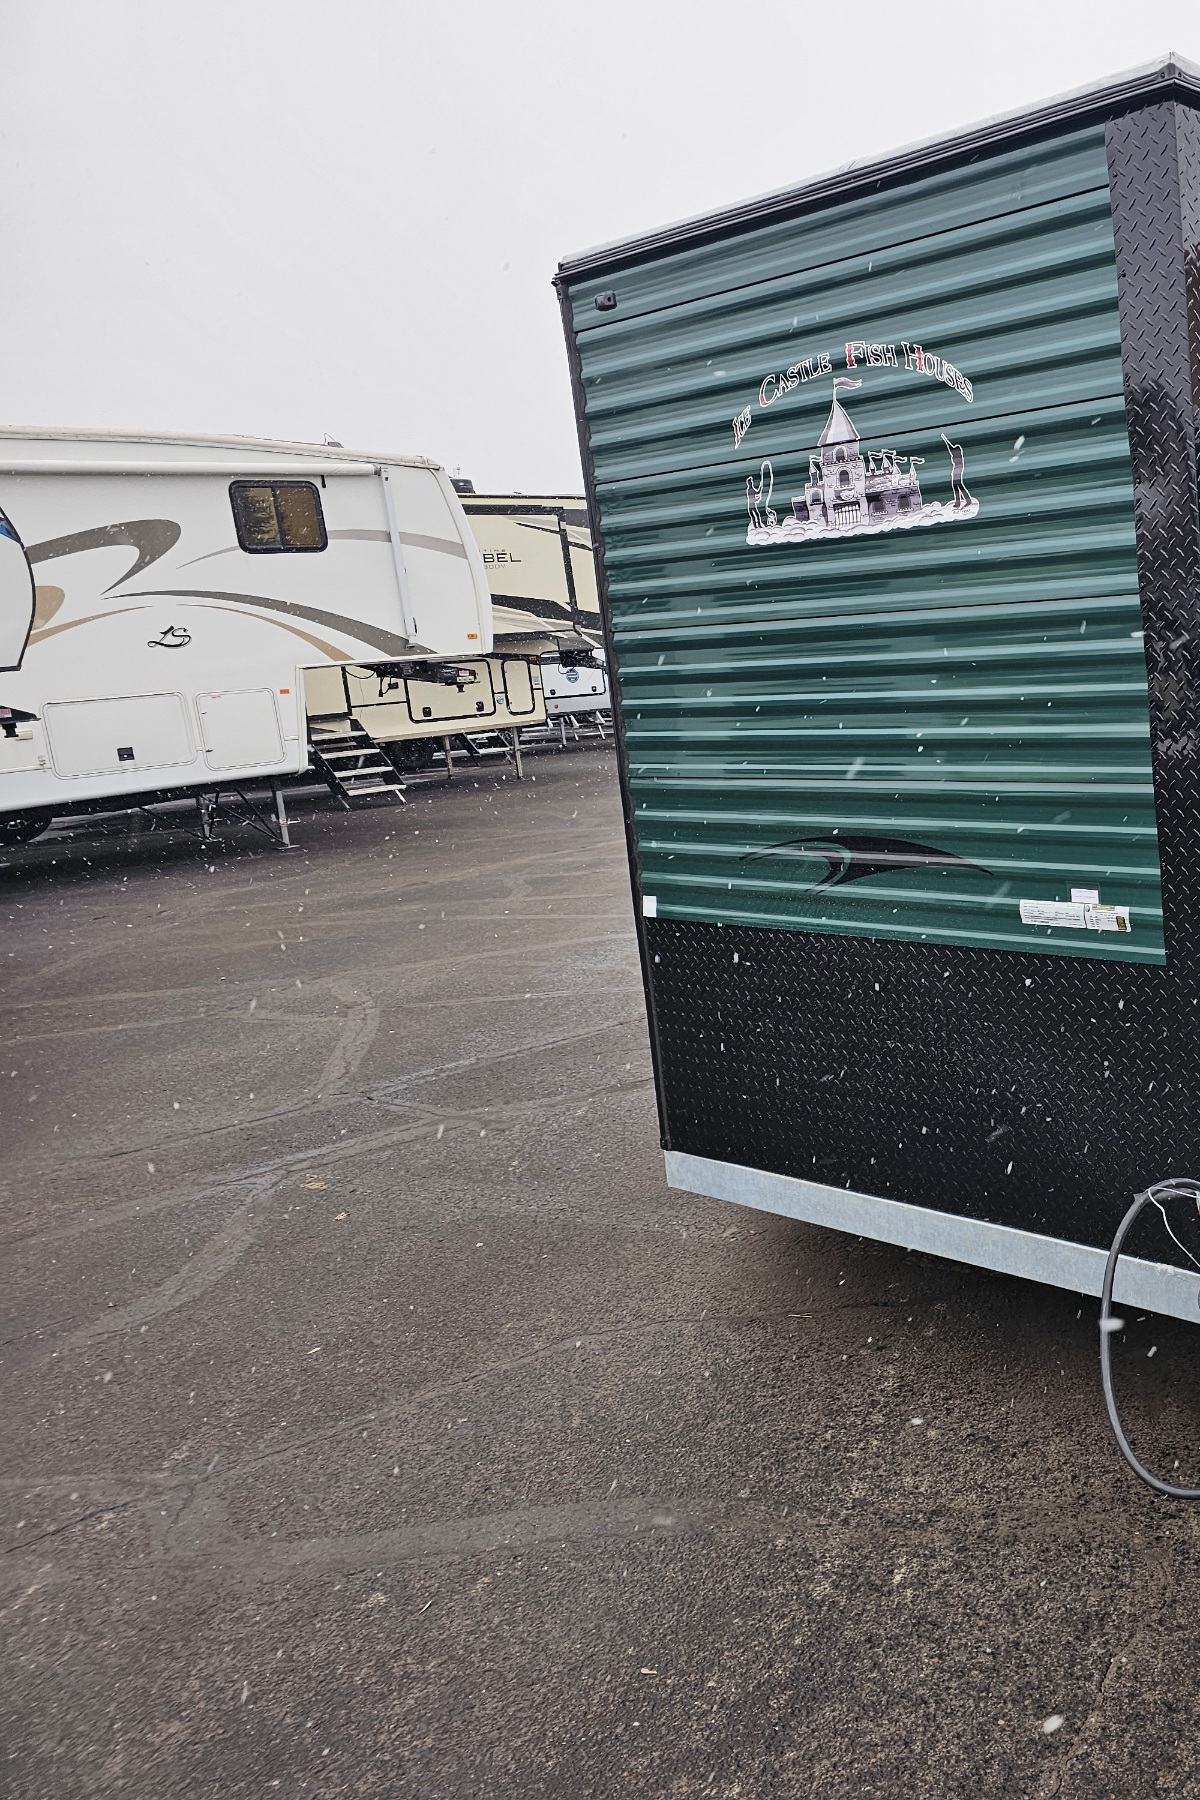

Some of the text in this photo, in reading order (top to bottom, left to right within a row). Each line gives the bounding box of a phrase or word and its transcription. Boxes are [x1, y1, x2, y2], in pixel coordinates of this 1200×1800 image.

[732, 341, 973, 449] ICE CASTLE FISH HOUSES
[482, 553, 522, 563] BEL
